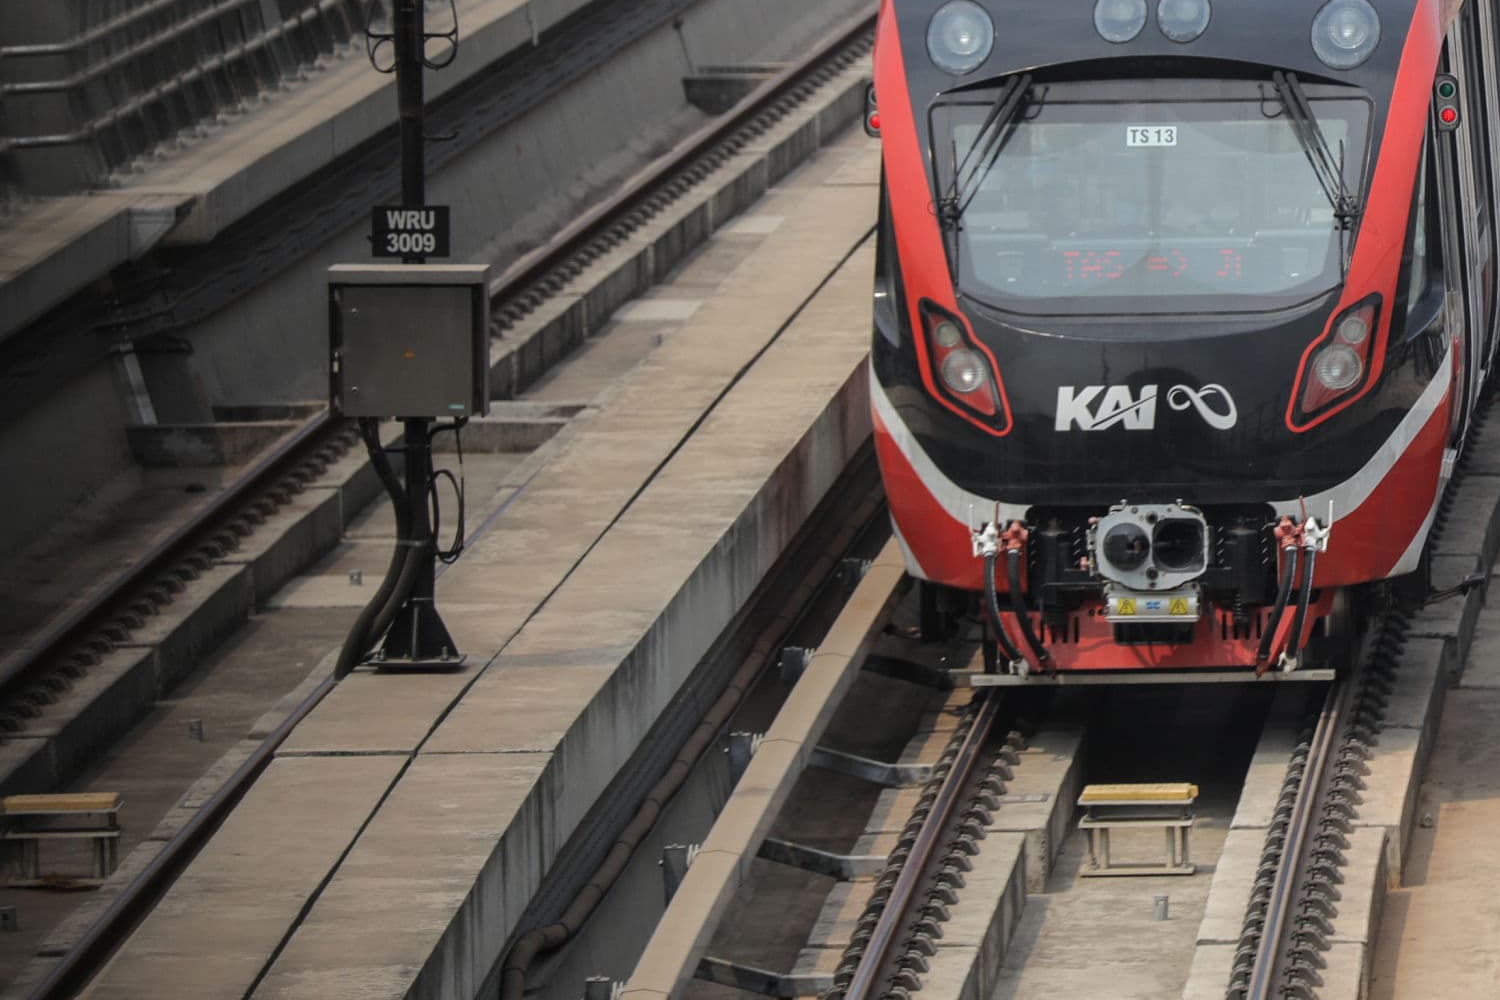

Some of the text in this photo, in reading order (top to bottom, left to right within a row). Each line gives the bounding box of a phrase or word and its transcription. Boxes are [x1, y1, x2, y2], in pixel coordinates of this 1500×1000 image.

[1130, 129, 1174, 143] TS 13
[386, 210, 436, 230] WRU
[386, 233, 436, 253] 3009
[1055, 384, 1158, 431] KAI
